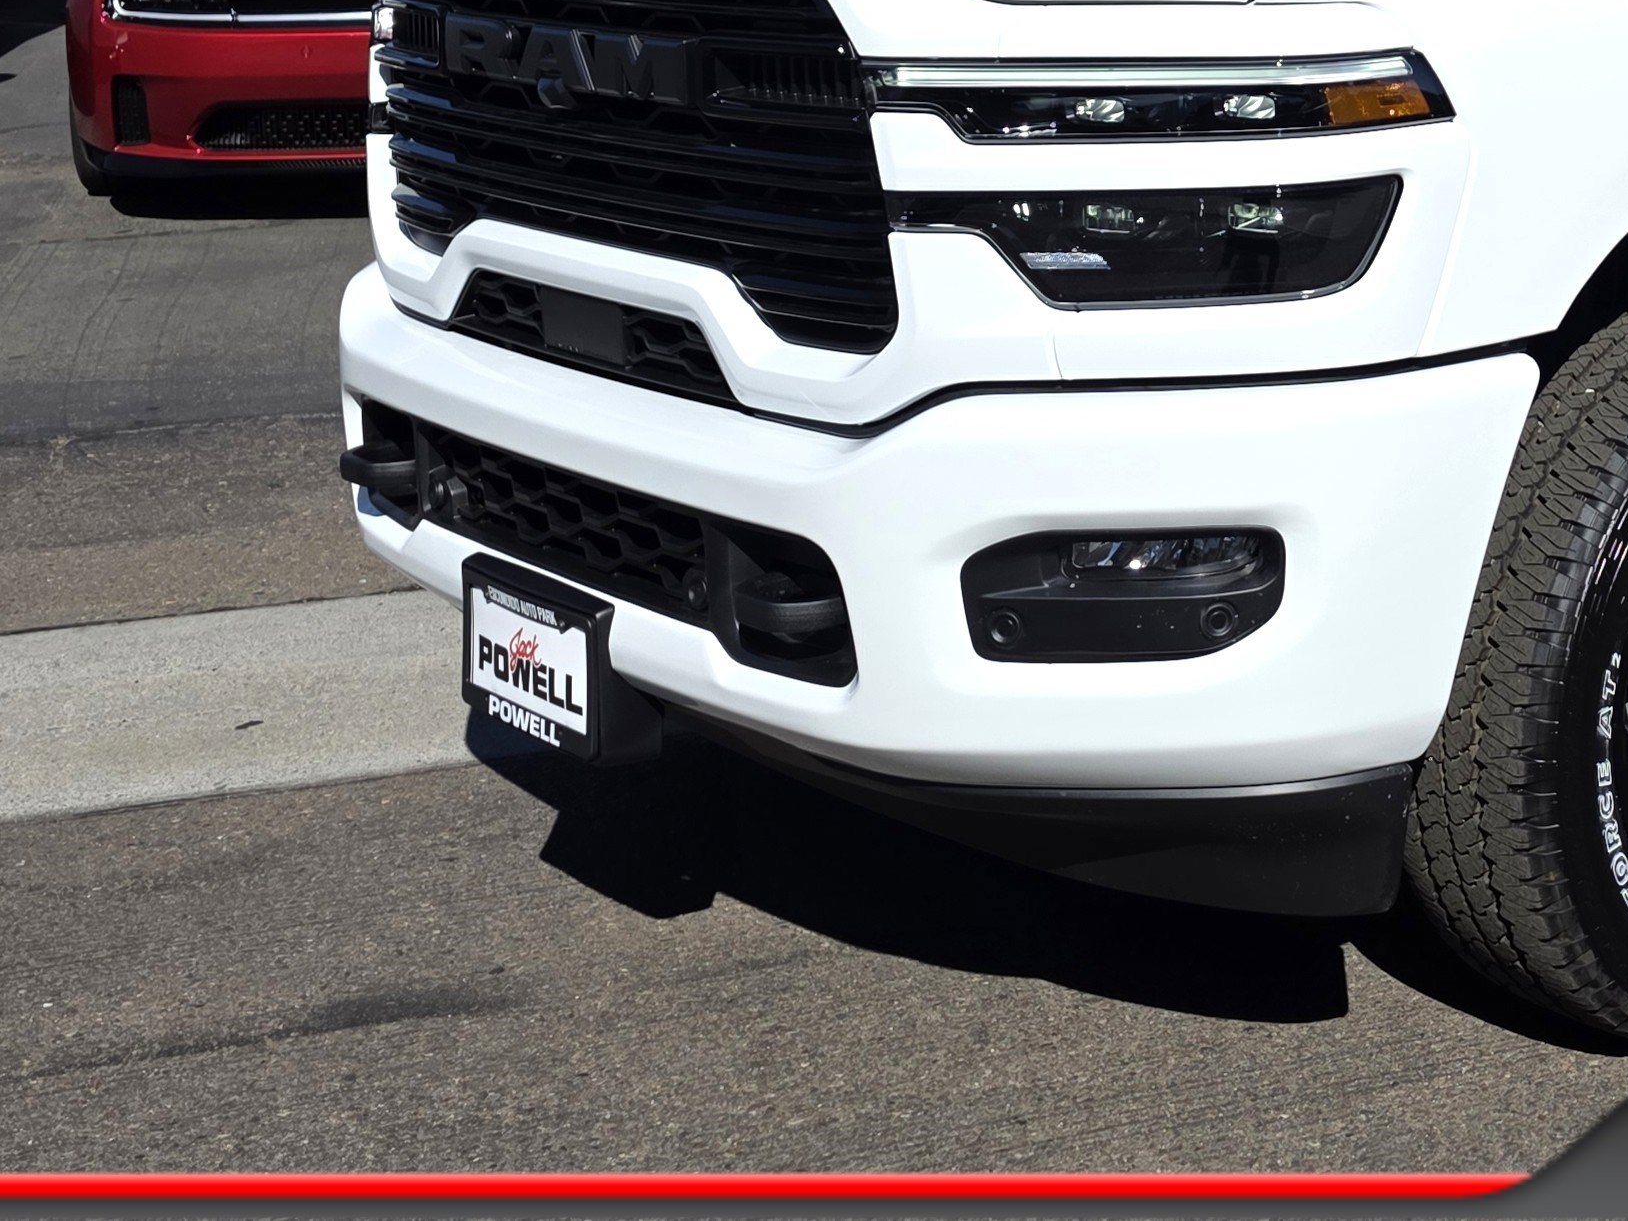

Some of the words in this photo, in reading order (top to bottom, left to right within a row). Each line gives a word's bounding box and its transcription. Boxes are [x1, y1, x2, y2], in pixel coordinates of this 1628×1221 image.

[445, 11, 687, 106] RAM
[487, 585, 521, 613] ESCONDIDO
[521, 599, 537, 618] AUTO
[537, 605, 558, 627] PARK
[478, 633, 584, 717] POWELL
[509, 627, 542, 673] Jack
[488, 693, 561, 748] POWELL
